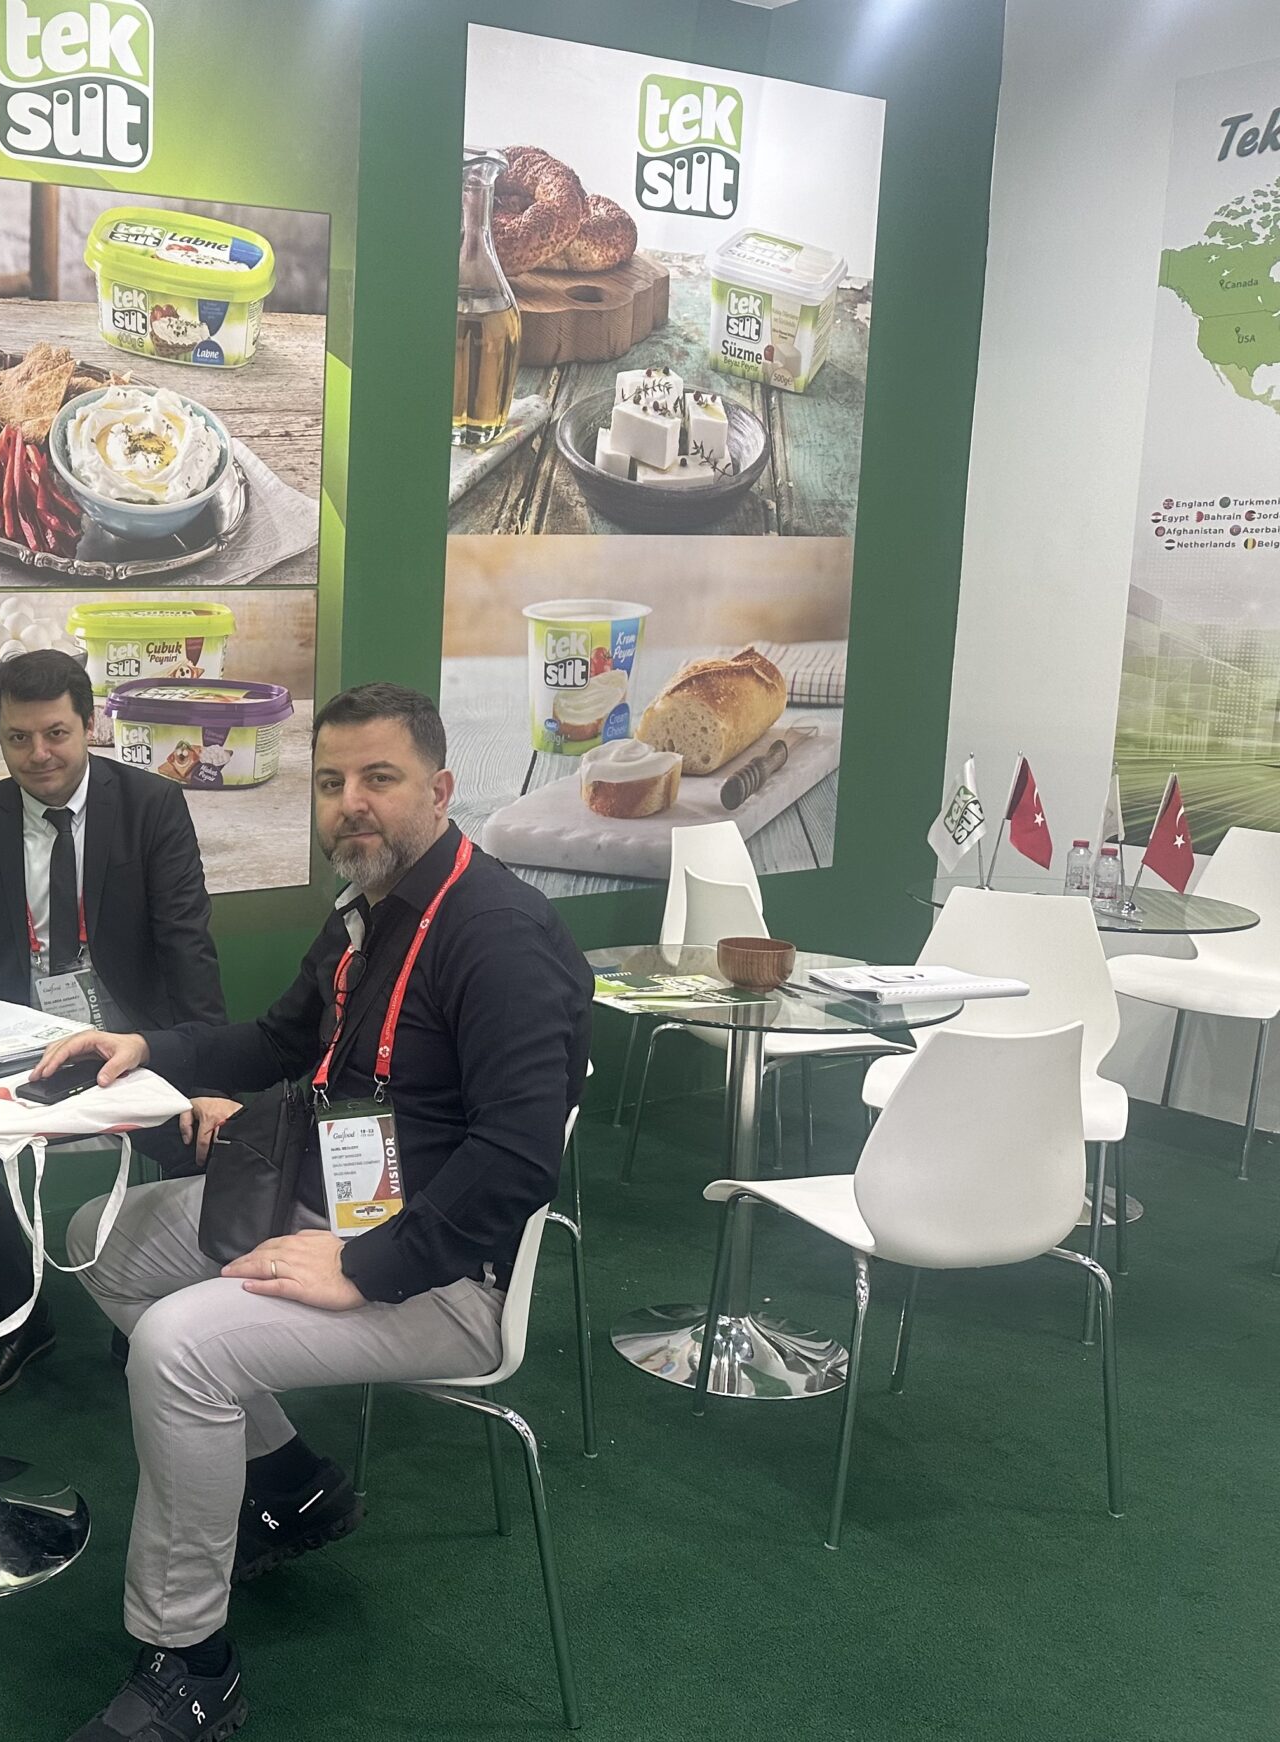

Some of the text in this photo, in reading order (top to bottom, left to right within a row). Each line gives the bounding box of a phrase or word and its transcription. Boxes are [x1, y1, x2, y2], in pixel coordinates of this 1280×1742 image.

[6, 0, 143, 77] tek
[6, 84, 143, 163] süt
[644, 83, 739, 149] tek
[641, 152, 735, 217] süt
[168, 232, 229, 252] Labne
[1225, 279, 1259, 290] Canada
[113, 283, 146, 311] tek
[729, 292, 761, 316] tek
[113, 311, 147, 334] süt
[728, 317, 761, 341] süt
[1237, 334, 1256, 345] USA
[197, 348, 220, 360] Labne
[721, 340, 763, 365] Süzme
[1176, 500, 1215, 509] England
[1162, 515, 1189, 523] Egypt
[1204, 513, 1242, 521] Bahrain
[1166, 527, 1224, 536] Afghanistan
[1177, 541, 1236, 549] Netherlands
[108, 642, 140, 661] tek
[146, 641, 182, 657] Çubuk
[546, 631, 587, 661] tek
[108, 660, 140, 676] süt
[546, 659, 587, 687] süt
[122, 726, 150, 745] tek
[123, 745, 151, 764] süt
[954, 801, 985, 843] süt
[385, 1137, 401, 1195] VISITOR
